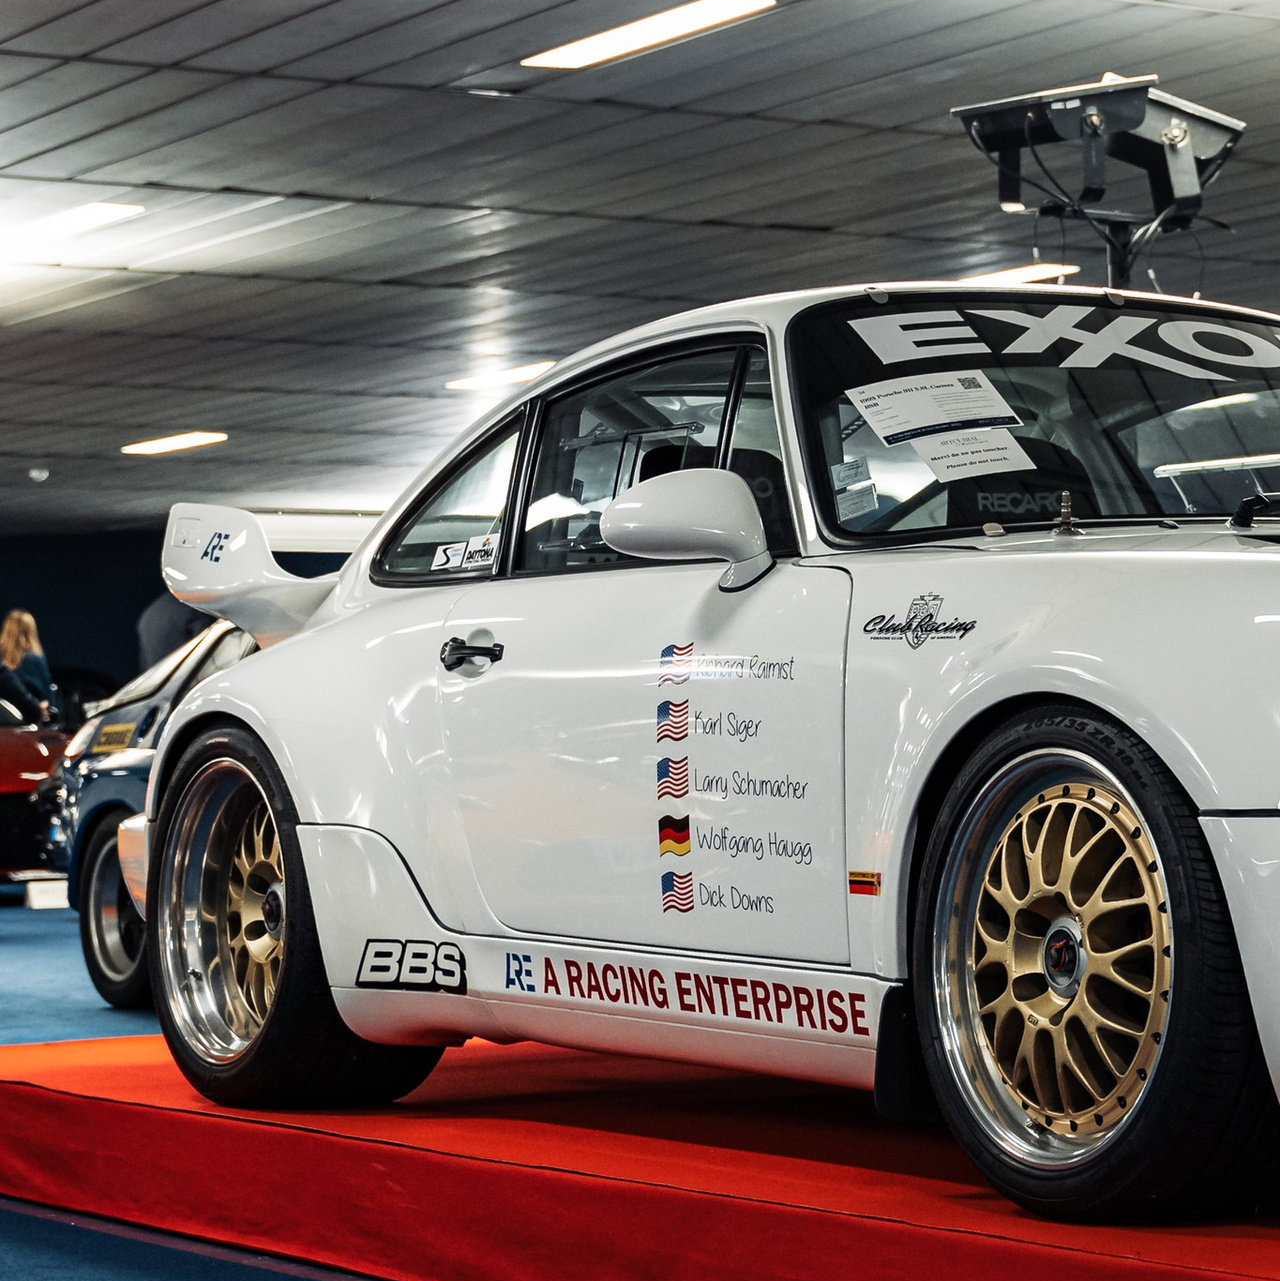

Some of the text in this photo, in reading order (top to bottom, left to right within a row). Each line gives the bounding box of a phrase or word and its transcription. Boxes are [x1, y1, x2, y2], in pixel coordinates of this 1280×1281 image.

[876, 389, 903, 400] Porsche
[929, 382, 954, 390] Carrera
[930, 454, 950, 462] Merci
[946, 462, 968, 470] Please
[466, 547, 494, 561] DAYTONA
[863, 613, 977, 640] Club Racing
[695, 655, 795, 681] Richard Raimist
[694, 710, 762, 742] Karl Siger
[1088, 728, 1115, 749] ZR
[1114, 748, 1135, 768] 18
[694, 770, 809, 801] Larry Schumacher
[695, 826, 813, 866] Wolfgang Haugg
[699, 883, 775, 914] Dick Downs
[357, 939, 466, 994] BBS
[542, 957, 562, 997] A
[568, 960, 668, 1010] RACING
[677, 972, 870, 1037] ENTERPRISE
